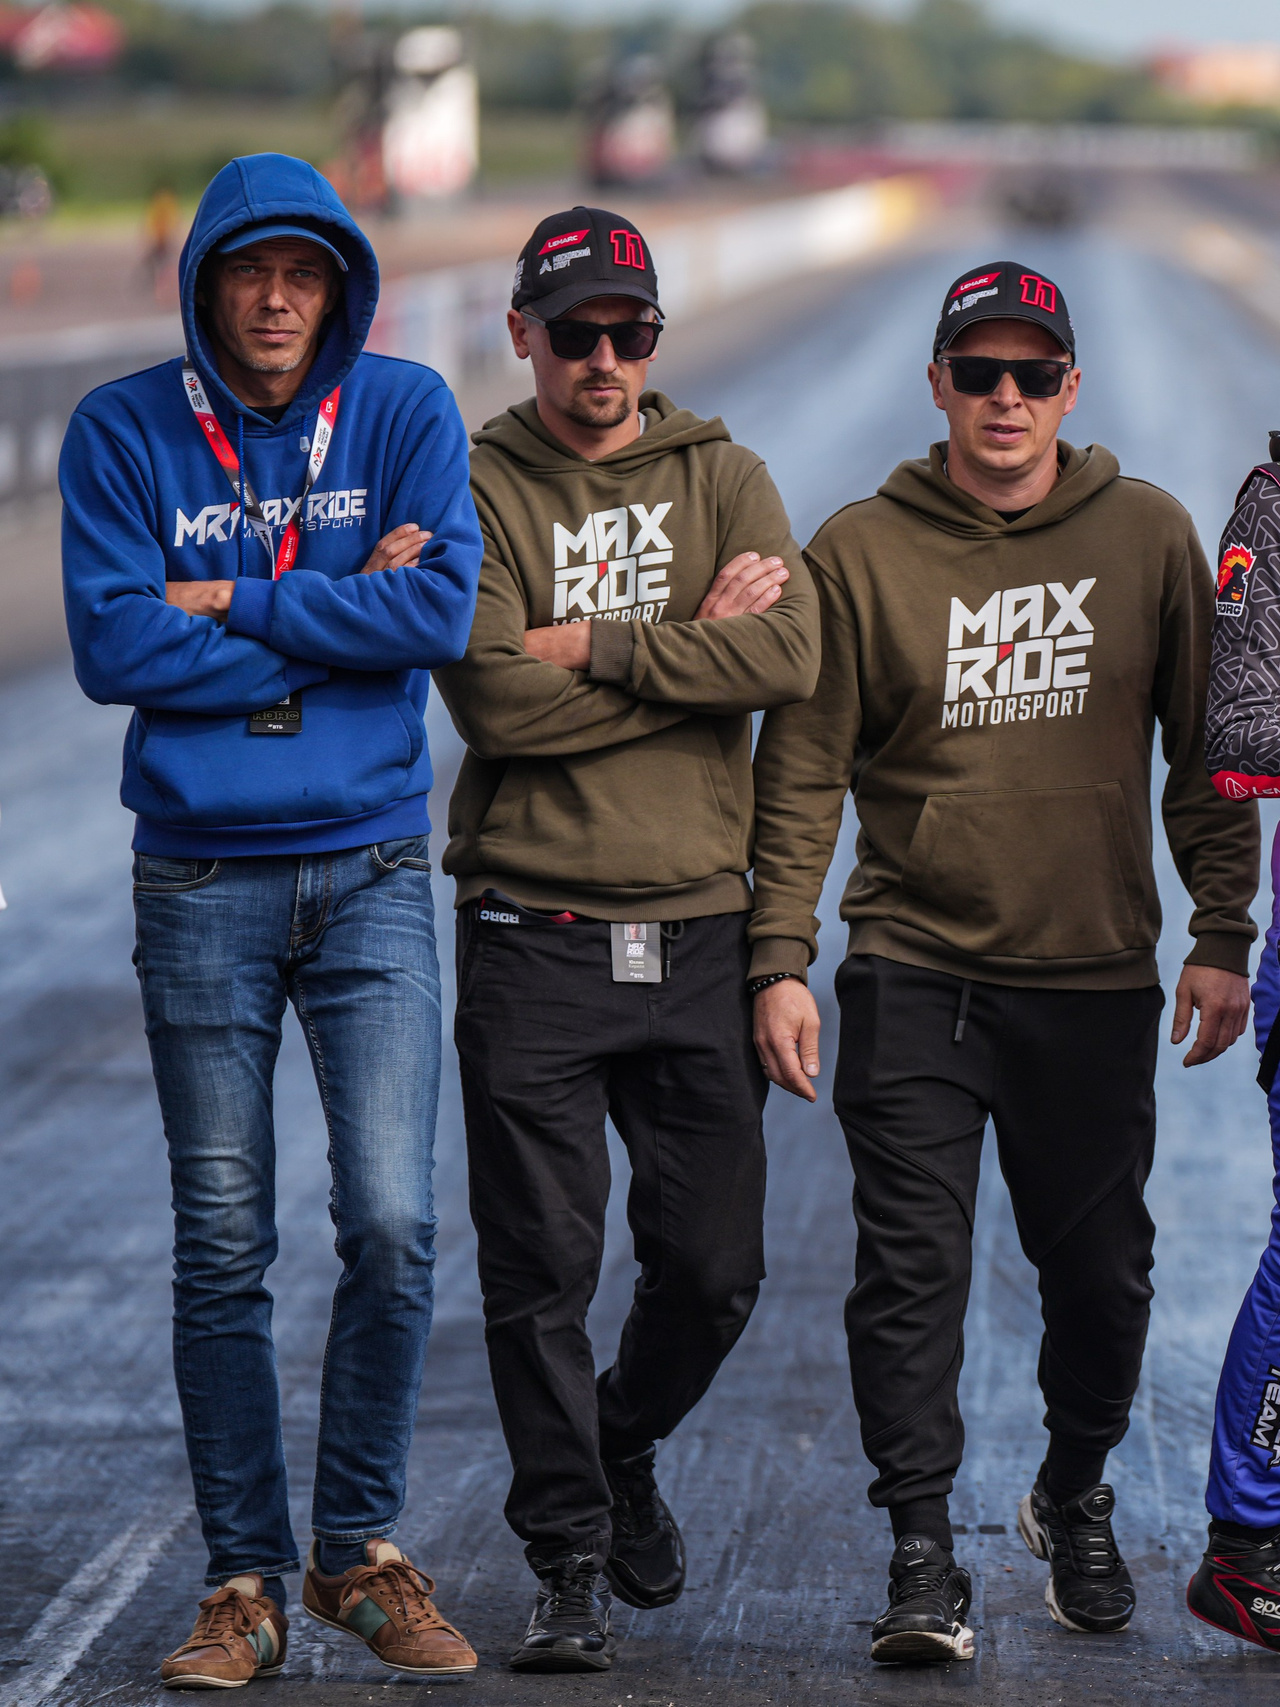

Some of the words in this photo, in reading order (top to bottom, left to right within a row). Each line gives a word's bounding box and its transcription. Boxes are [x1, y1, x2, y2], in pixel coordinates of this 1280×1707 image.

[610, 229, 646, 271] 11
[1019, 274, 1056, 314] 11
[307, 489, 367, 521] RIDE
[553, 502, 674, 568] MAX
[553, 550, 673, 618] RIDE
[948, 577, 1097, 649] MAX
[944, 632, 1094, 702] RIDE
[941, 688, 1089, 729] MOTORSPORT
